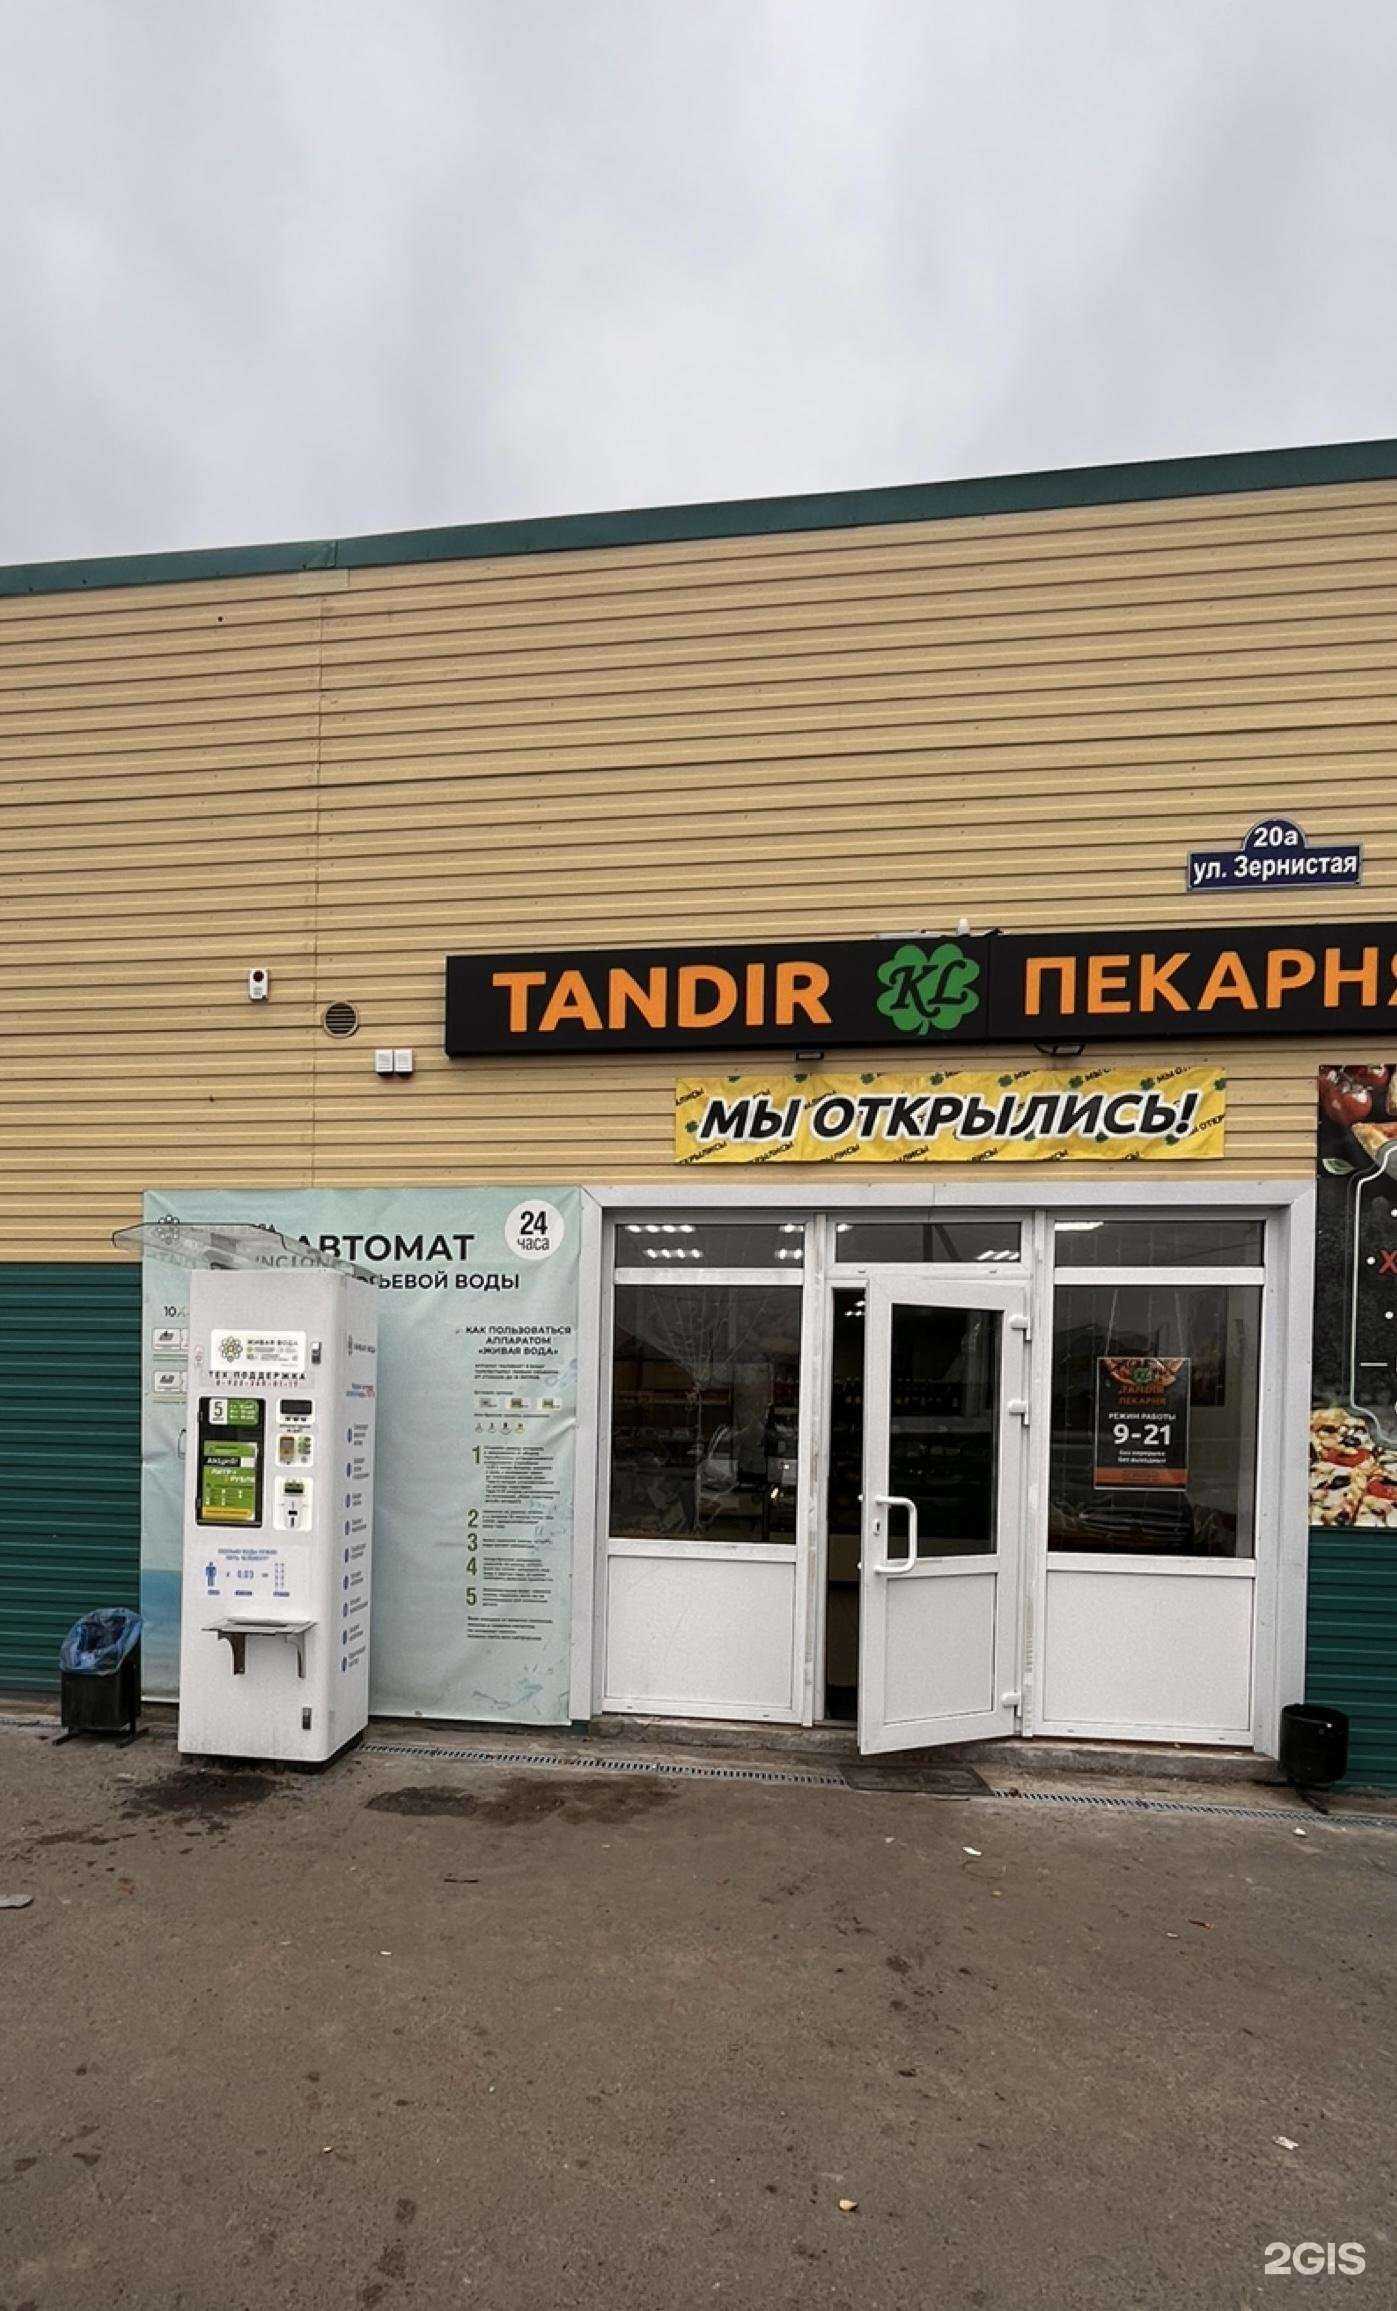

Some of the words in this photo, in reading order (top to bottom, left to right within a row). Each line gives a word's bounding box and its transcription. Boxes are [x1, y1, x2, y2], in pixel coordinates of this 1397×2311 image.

[1253, 825, 1299, 848] 20а
[1193, 860, 1228, 886] ул.
[1233, 854, 1357, 882] Зернистая
[492, 961, 832, 1033] TANDIR
[700, 1097, 802, 1140] МЫ
[812, 1091, 1199, 1139] ОТКРЫЛИСЬ!
[520, 1210, 548, 1235] 24
[517, 1237, 550, 1251] часа
[455, 1273, 519, 1292] ВОДЫ
[465, 1325, 486, 1335] КАК
[489, 1325, 571, 1336] ПОЛЬЗОВАТЬСЯ
[485, 1336, 552, 1346] АППАРАТОМ
[1108, 1412, 1140, 1420] РЕЖИМ
[1141, 1412, 1177, 1421] РАБОТЫ
[1113, 1423, 1171, 1446] 9-21
[472, 1445, 480, 1464] 1
[467, 1508, 480, 1529] 2
[467, 1532, 479, 1552] 3
[465, 1556, 478, 1577] 4
[465, 1586, 478, 1607] 5
